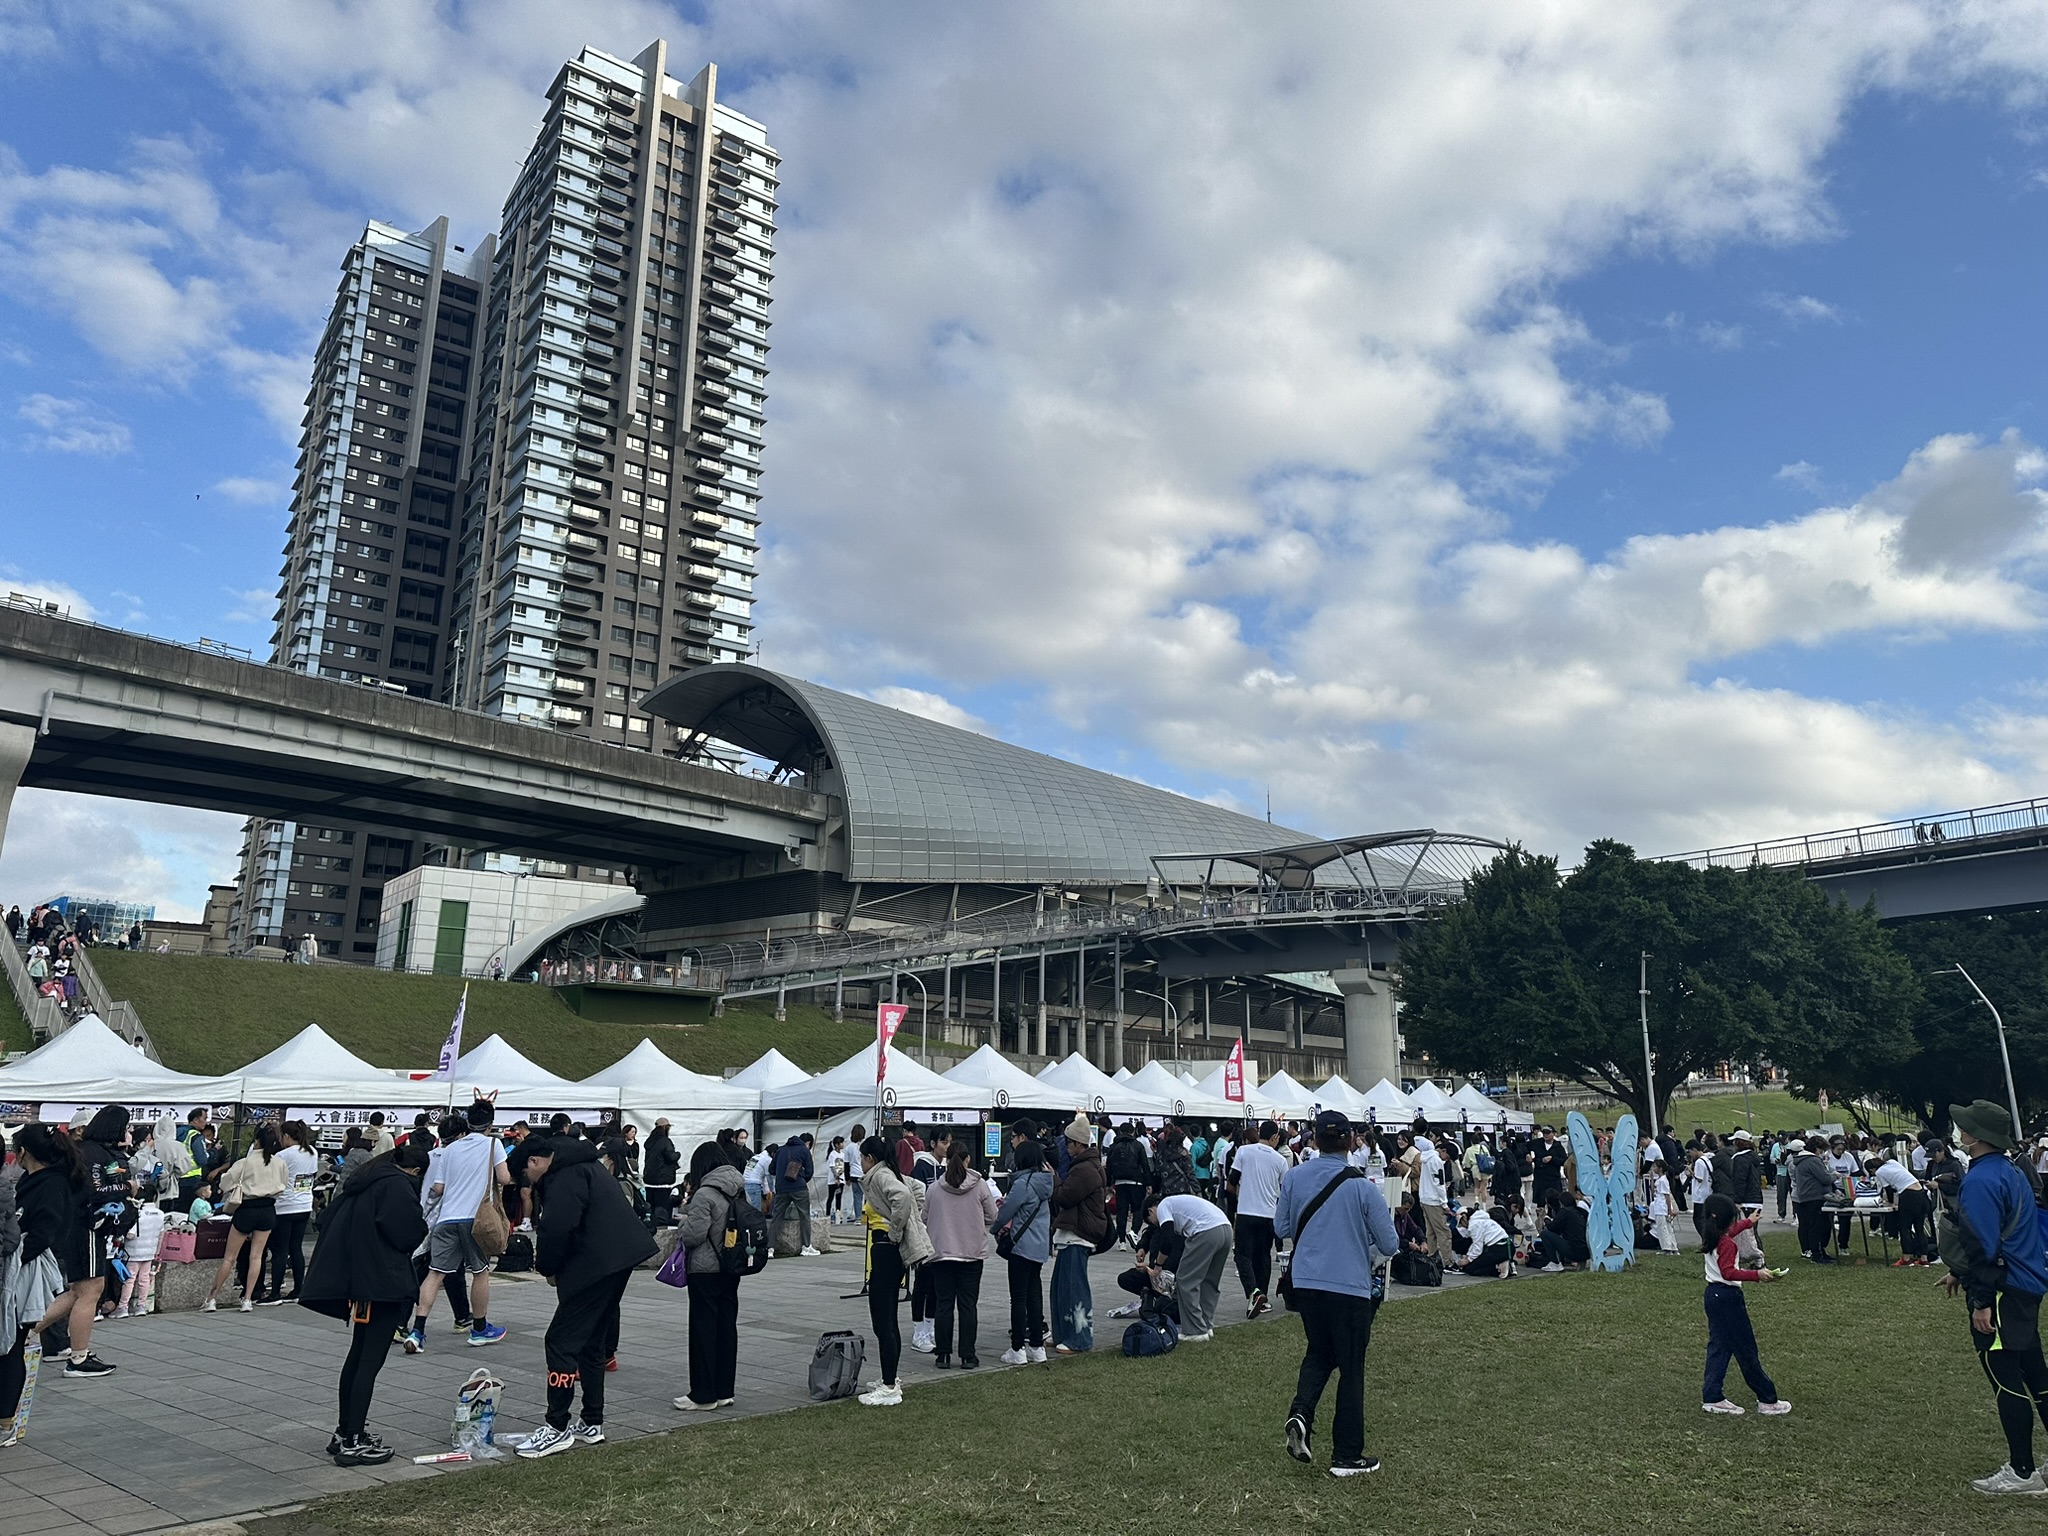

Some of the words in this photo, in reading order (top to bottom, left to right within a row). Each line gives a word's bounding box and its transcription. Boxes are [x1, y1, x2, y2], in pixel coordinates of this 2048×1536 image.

[314, 1110, 399, 1124] 大會指揮心
[931, 1112, 954, 1123] 寄物區
[548, 1370, 576, 1388] ORT
